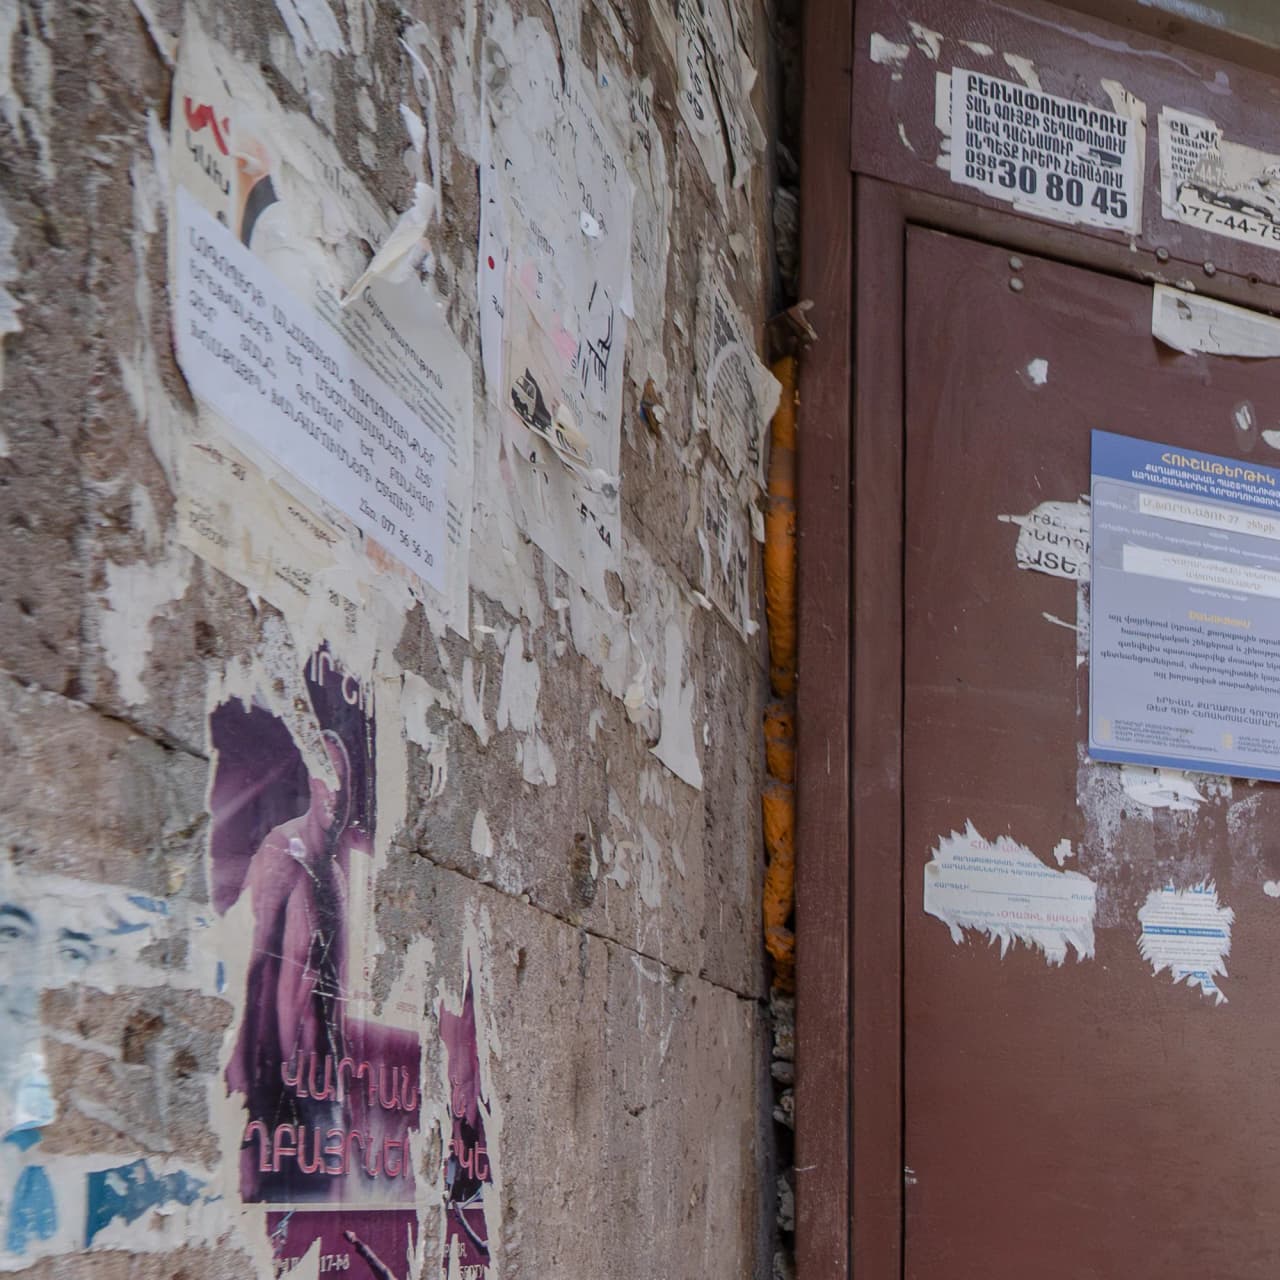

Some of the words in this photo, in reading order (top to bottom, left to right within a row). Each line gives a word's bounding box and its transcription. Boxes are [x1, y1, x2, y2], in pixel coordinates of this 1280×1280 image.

[966, 94, 991, 116] ՏԱՆ
[994, 102, 1040, 129] ԳՈՒՅՔԻ
[1043, 117, 1127, 155] ՏԵՂԱՓՈԽՈՒՄ
[967, 74, 1128, 137] ԲԵՌՆԱՓՈԽԱԴՐՈՒՄ
[965, 131, 1020, 159] ԱՆՊԵՏՔ
[1022, 144, 1061, 171] ԻՐԵՐԻ
[966, 112, 1000, 137] ՆԱԵՎ
[1002, 121, 1074, 157] ԴԱՇՆԱՄՈՒՐ
[965, 164, 994, 184] 091
[965, 149, 997, 169] 098
[998, 159, 1037, 194] 30
[1045, 172, 1084, 207] 80
[1091, 186, 1128, 218] 45
[1161, 452, 1276, 487] ՀՈՒՇԱԹԵՐԹԻԿ
